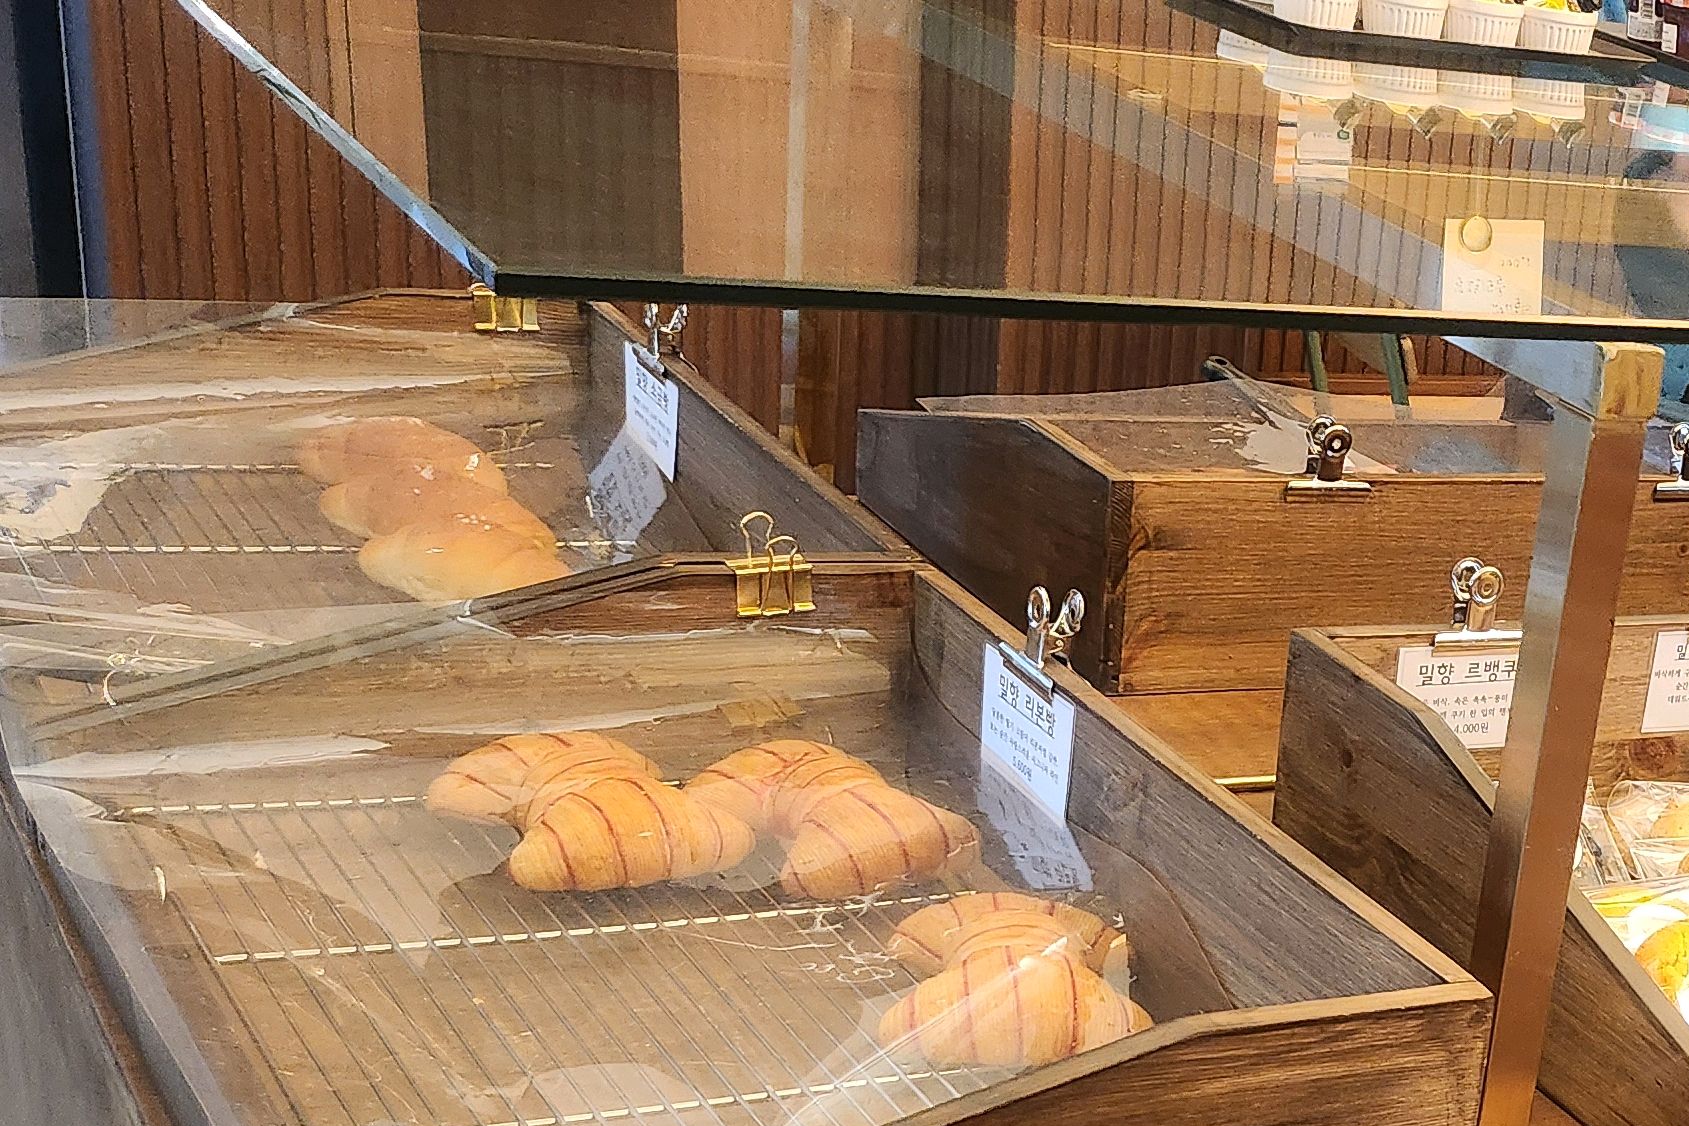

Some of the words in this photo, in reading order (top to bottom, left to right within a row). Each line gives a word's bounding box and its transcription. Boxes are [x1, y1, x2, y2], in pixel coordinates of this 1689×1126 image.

[1418, 662, 1455, 686] 밀향
[1464, 659, 1517, 683] 르뱅쿠
[1654, 668, 1682, 679] 바삭하게
[998, 673, 1020, 710] 밀향
[1454, 696, 1469, 706] 속은
[1451, 710, 1466, 719] 쿠키
[1469, 709, 1477, 719] 한
